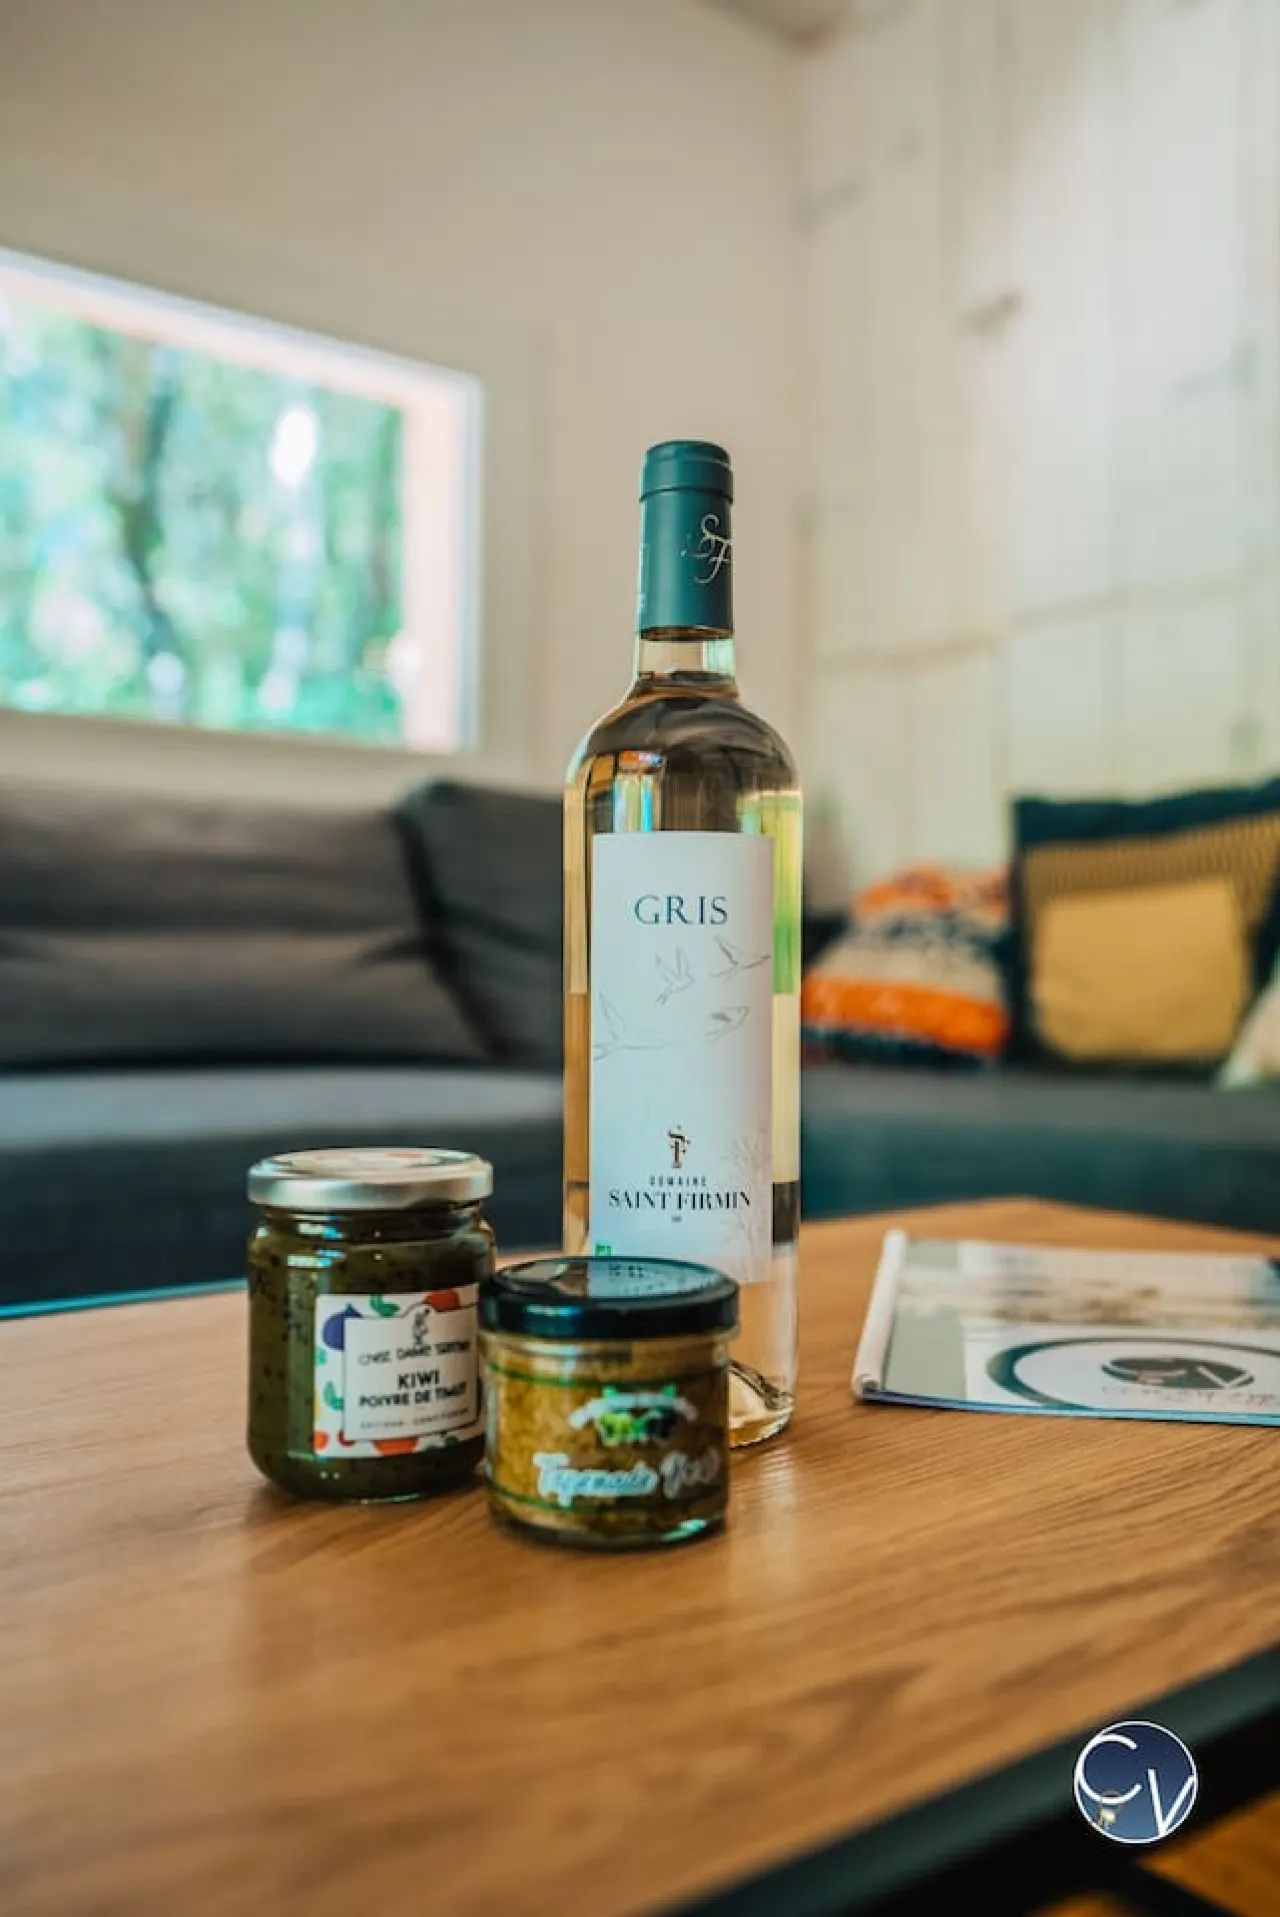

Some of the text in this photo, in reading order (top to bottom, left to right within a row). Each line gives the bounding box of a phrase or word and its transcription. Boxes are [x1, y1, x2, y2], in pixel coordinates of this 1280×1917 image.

[634, 895, 728, 925] GRIS
[609, 1189, 751, 1210] SAINT FIRMIN
[398, 1369, 440, 1390] KIWI
[358, 1393, 409, 1407] POIVRE
[415, 1390, 430, 1404] DE
